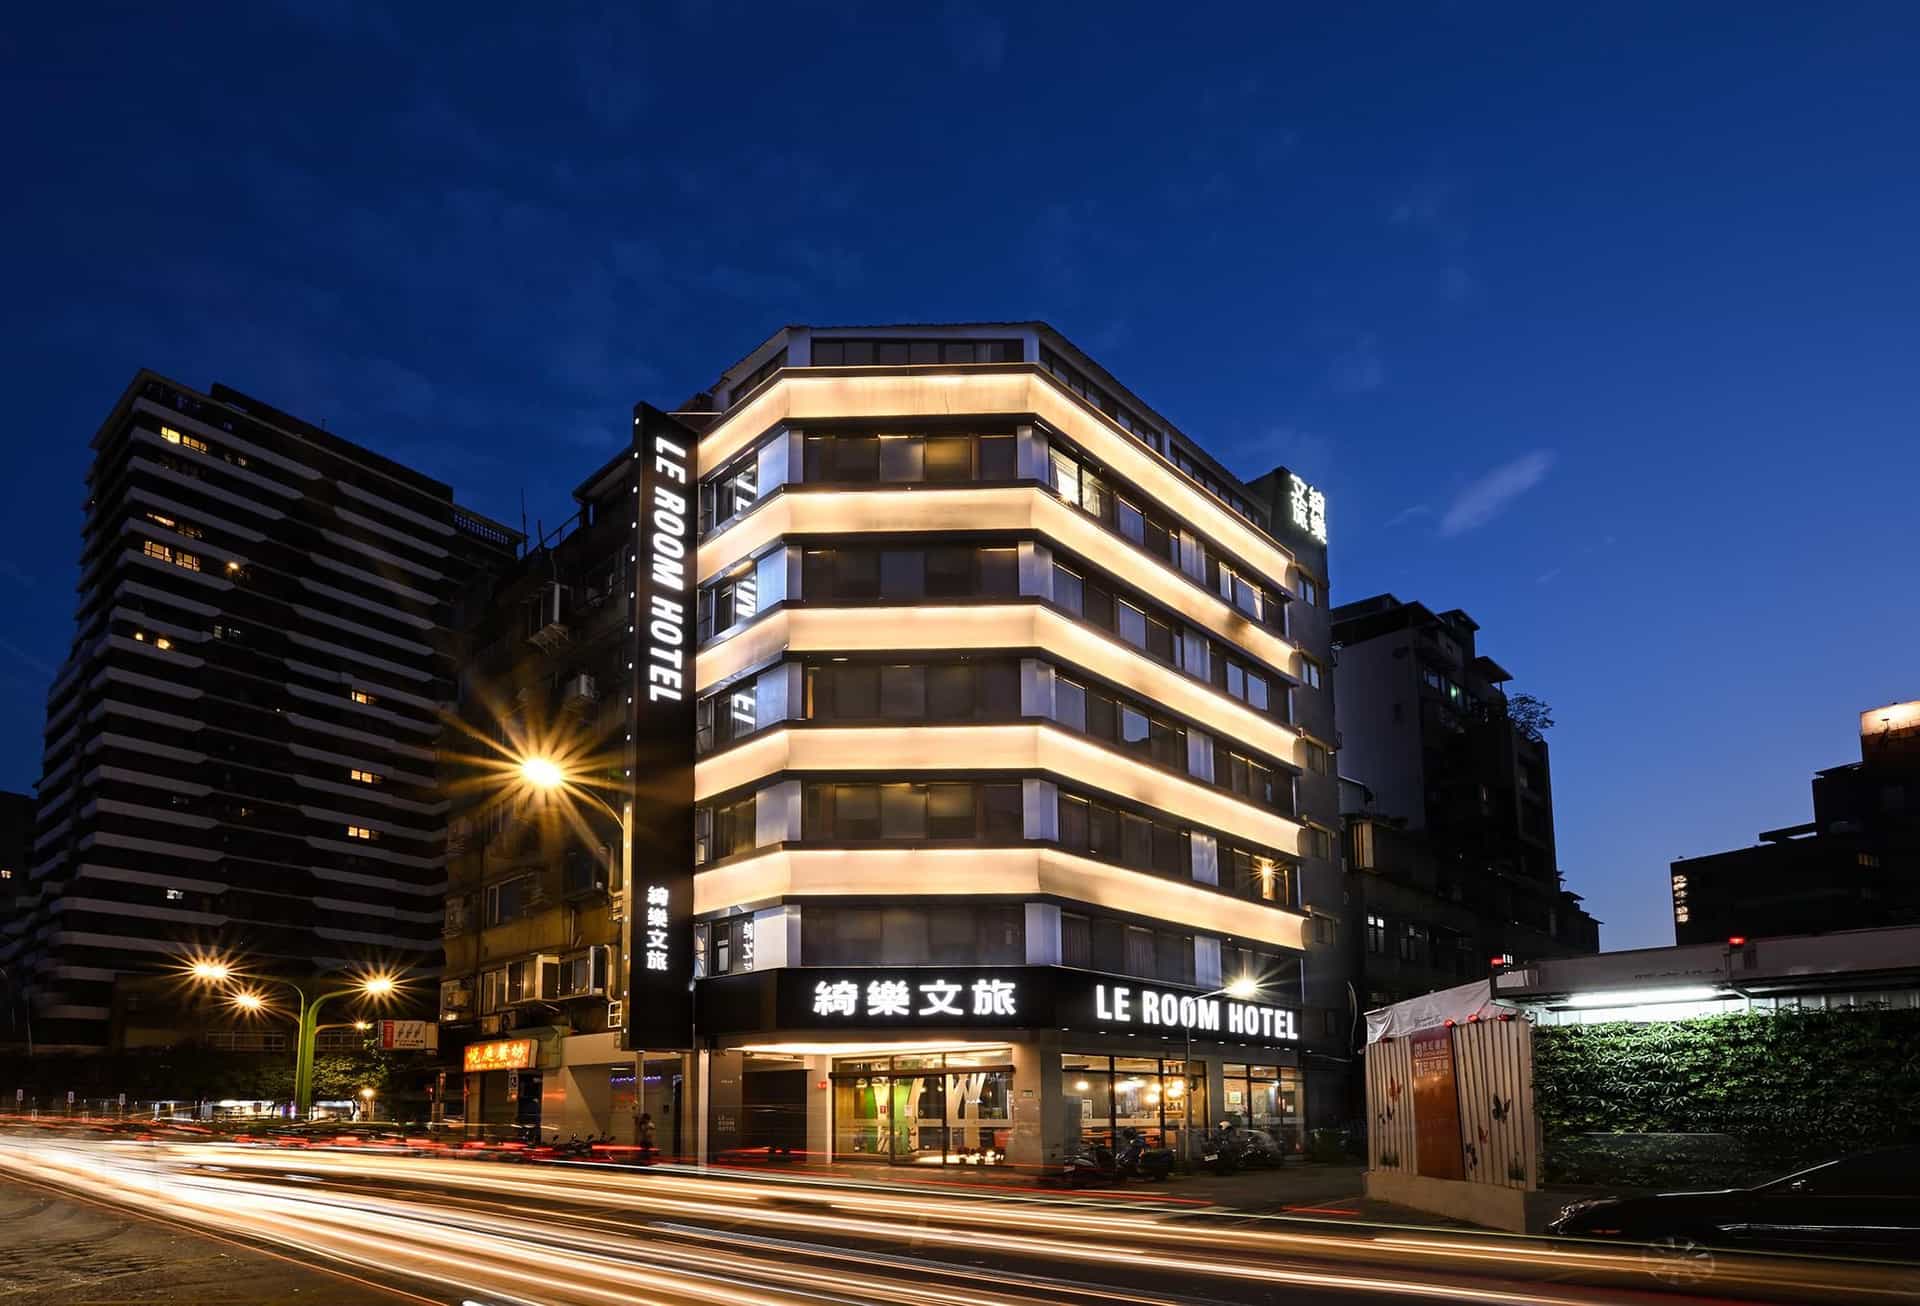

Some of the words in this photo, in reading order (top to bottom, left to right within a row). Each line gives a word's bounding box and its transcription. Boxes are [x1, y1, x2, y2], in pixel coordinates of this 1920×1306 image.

[655, 436, 687, 484] LE
[651, 485, 687, 592] ROOM
[649, 595, 684, 702] HOTEL
[645, 885, 670, 971] 綺樂文旅
[812, 978, 1018, 1017] 綺樂文旅
[1095, 984, 1132, 1022] LE
[1141, 989, 1221, 1031] ROOM
[1228, 1002, 1299, 1040] HOTEL
